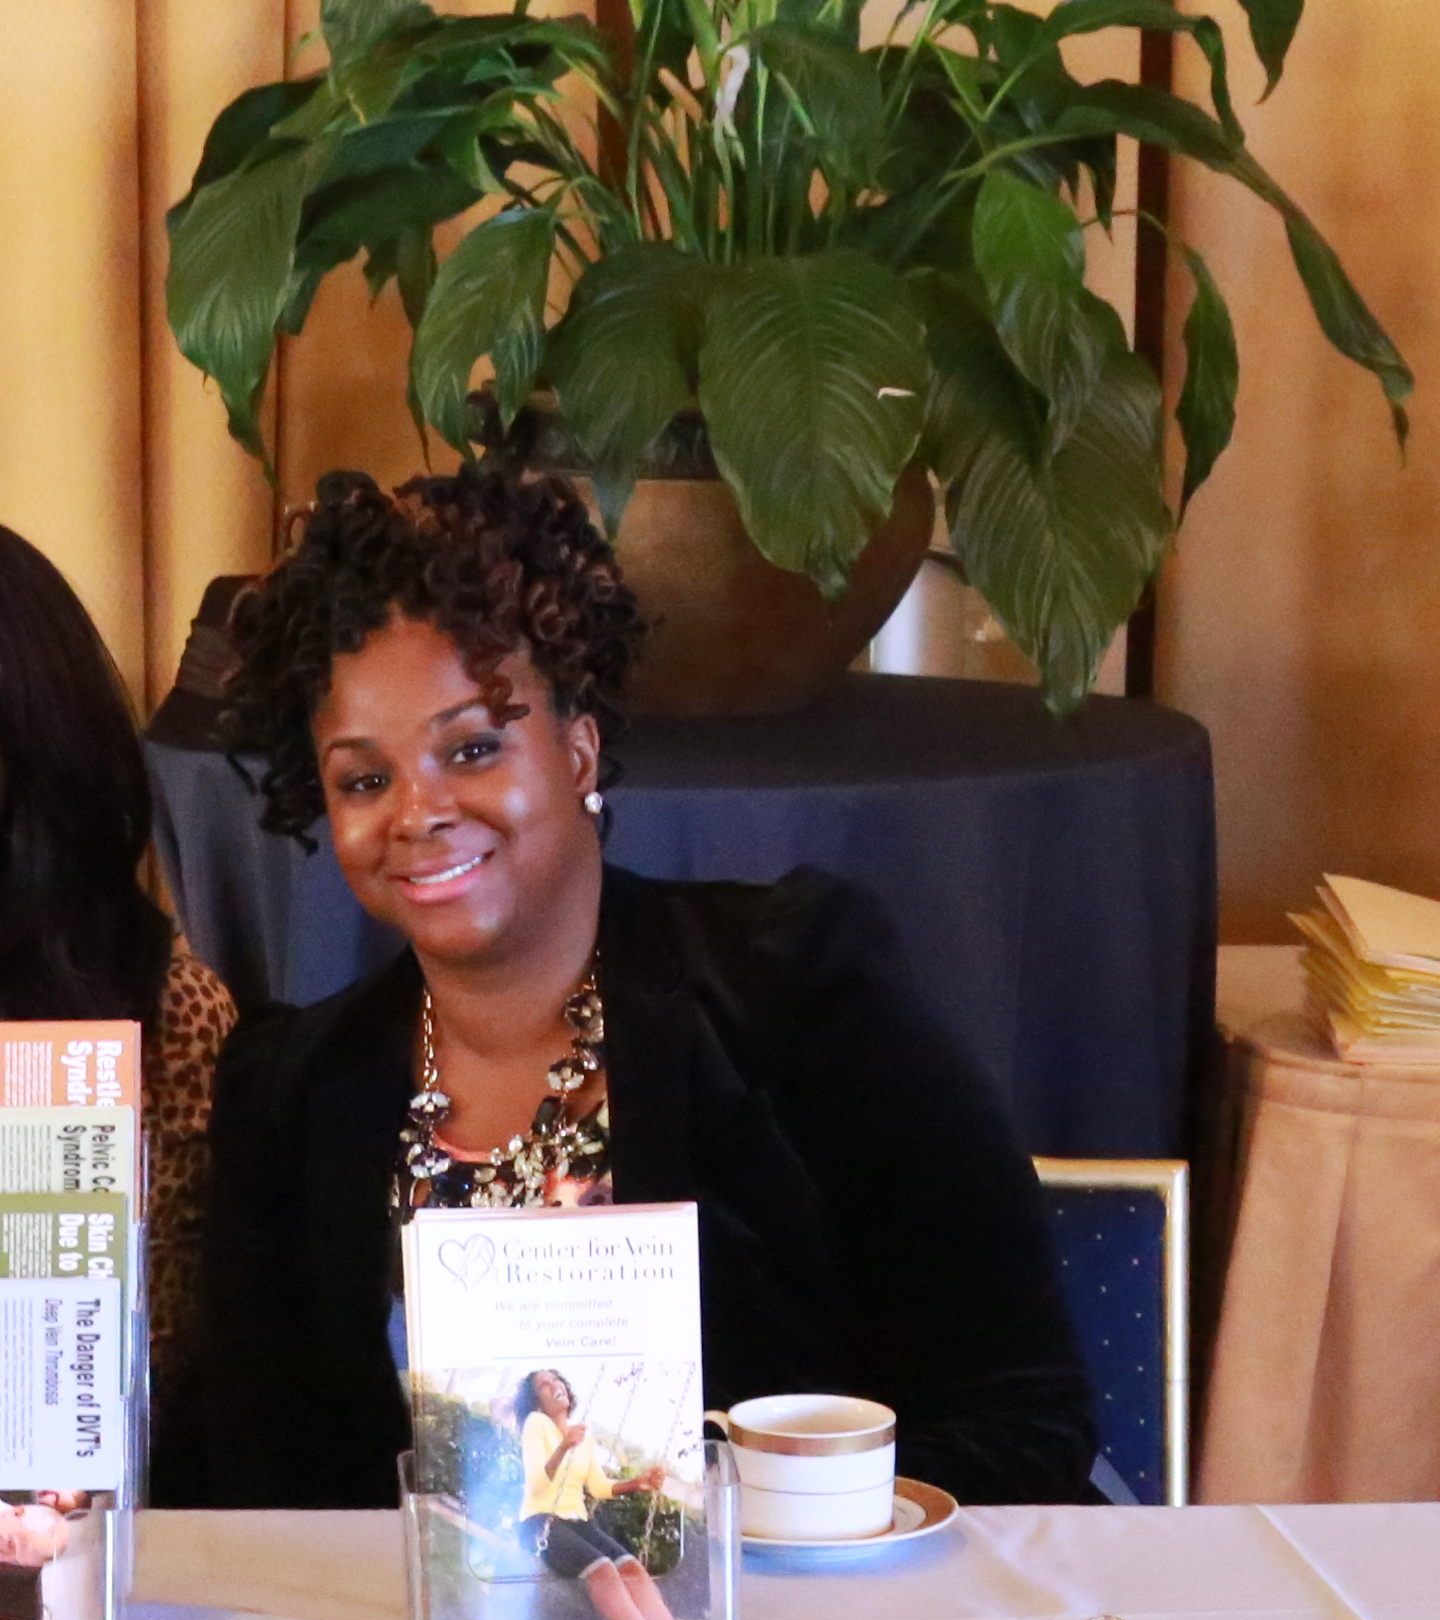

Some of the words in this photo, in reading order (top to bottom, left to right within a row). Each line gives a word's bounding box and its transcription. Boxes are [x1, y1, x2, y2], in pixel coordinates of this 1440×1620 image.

[61, 1041, 92, 1106] Syndr
[92, 1125, 116, 1170] Pelvic
[58, 1214, 85, 1249] Due
[88, 1213, 115, 1252] Skin
[503, 1239, 580, 1258] Center
[588, 1237, 621, 1259] for
[624, 1234, 674, 1257] Vein
[58, 1254, 83, 1271] to
[506, 1257, 675, 1284] Restoration
[44, 1299, 62, 1322] Deep
[77, 1299, 100, 1327] The
[495, 1301, 514, 1312] We
[520, 1302, 540, 1311] are
[545, 1299, 613, 1310] committed
[45, 1327, 62, 1346] Vein
[519, 1319, 533, 1330] to
[536, 1320, 566, 1332] your
[570, 1317, 629, 1330] complete
[545, 1337, 575, 1348] Vein
[580, 1335, 617, 1347] Care!
[70, 1333, 100, 1386] Danger
[45, 1351, 63, 1406] Thrombosis
[76, 1393, 101, 1408] of
[77, 1415, 101, 1458] DVT's
